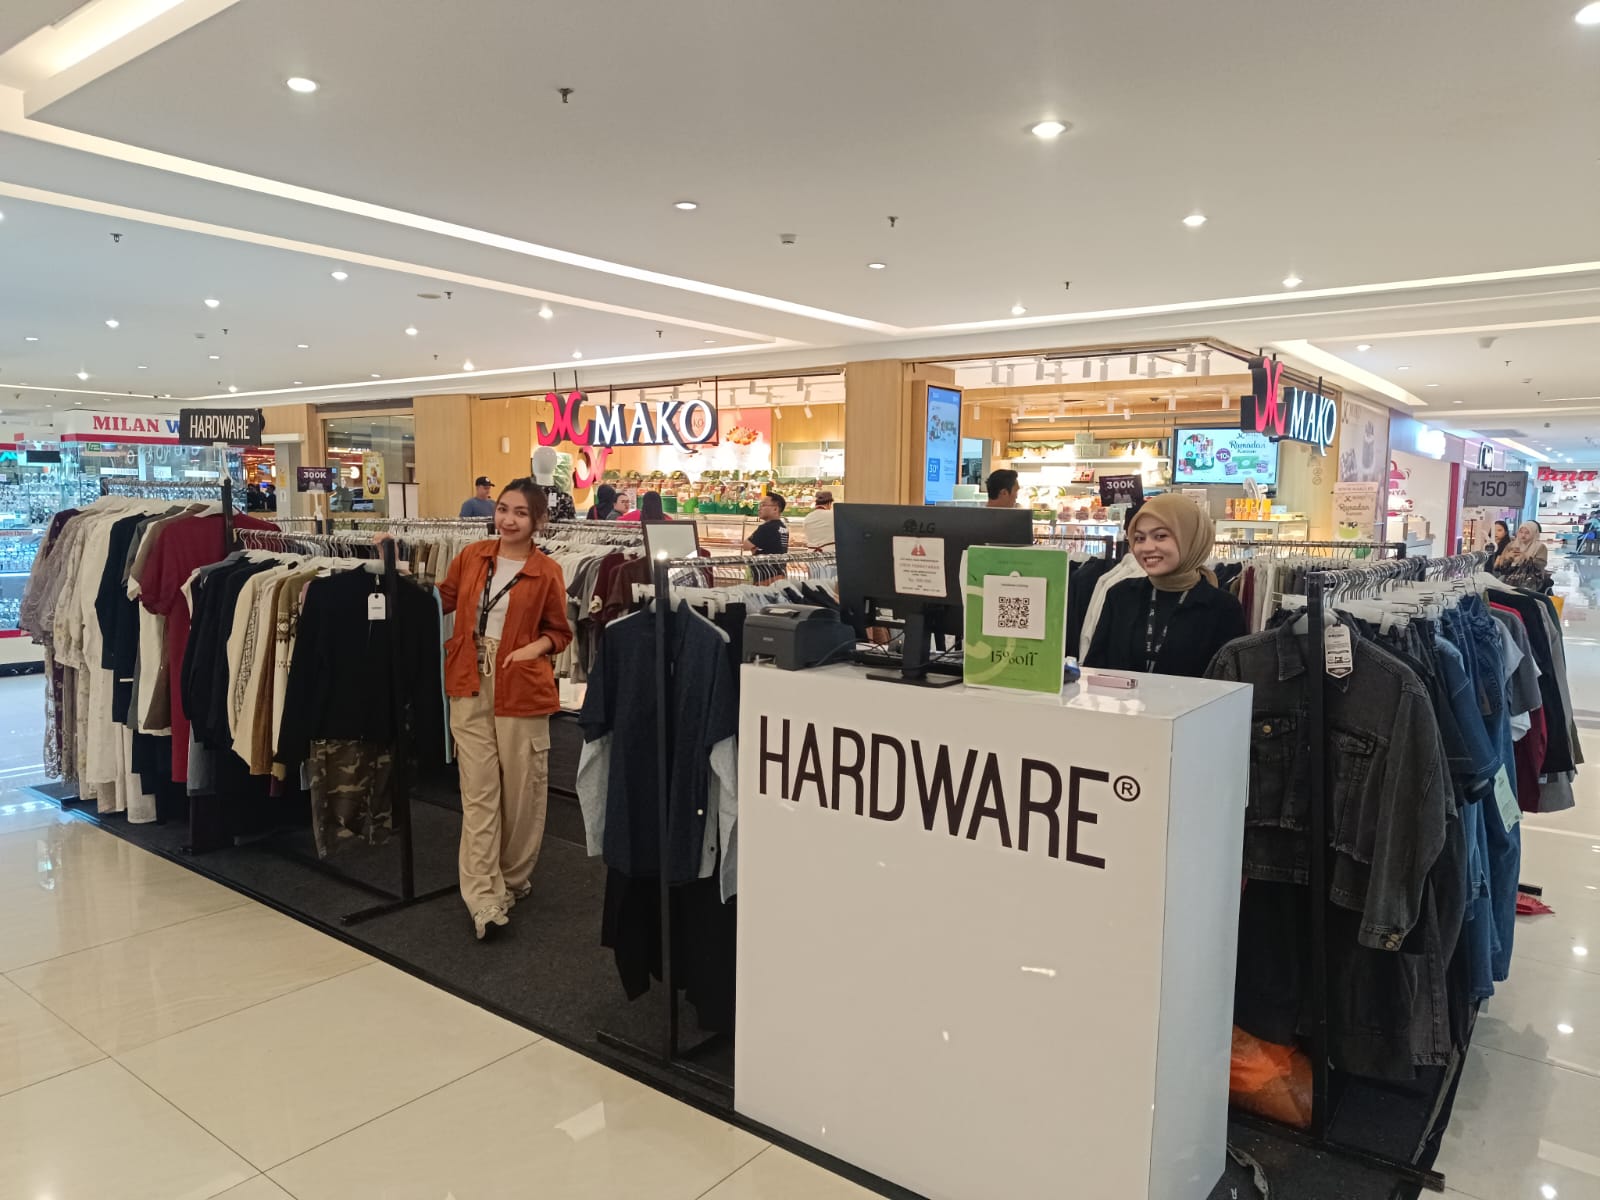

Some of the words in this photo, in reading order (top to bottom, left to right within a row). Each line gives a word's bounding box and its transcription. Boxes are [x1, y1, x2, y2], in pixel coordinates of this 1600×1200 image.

[93, 416, 159, 433] MILAN
[592, 399, 714, 454] MAKO
[1289, 387, 1337, 457] MAKO
[303, 471, 327, 479] 300K
[1106, 480, 1135, 490] 300K
[1480, 480, 1507, 497] 150
[919, 521, 935, 534] LG
